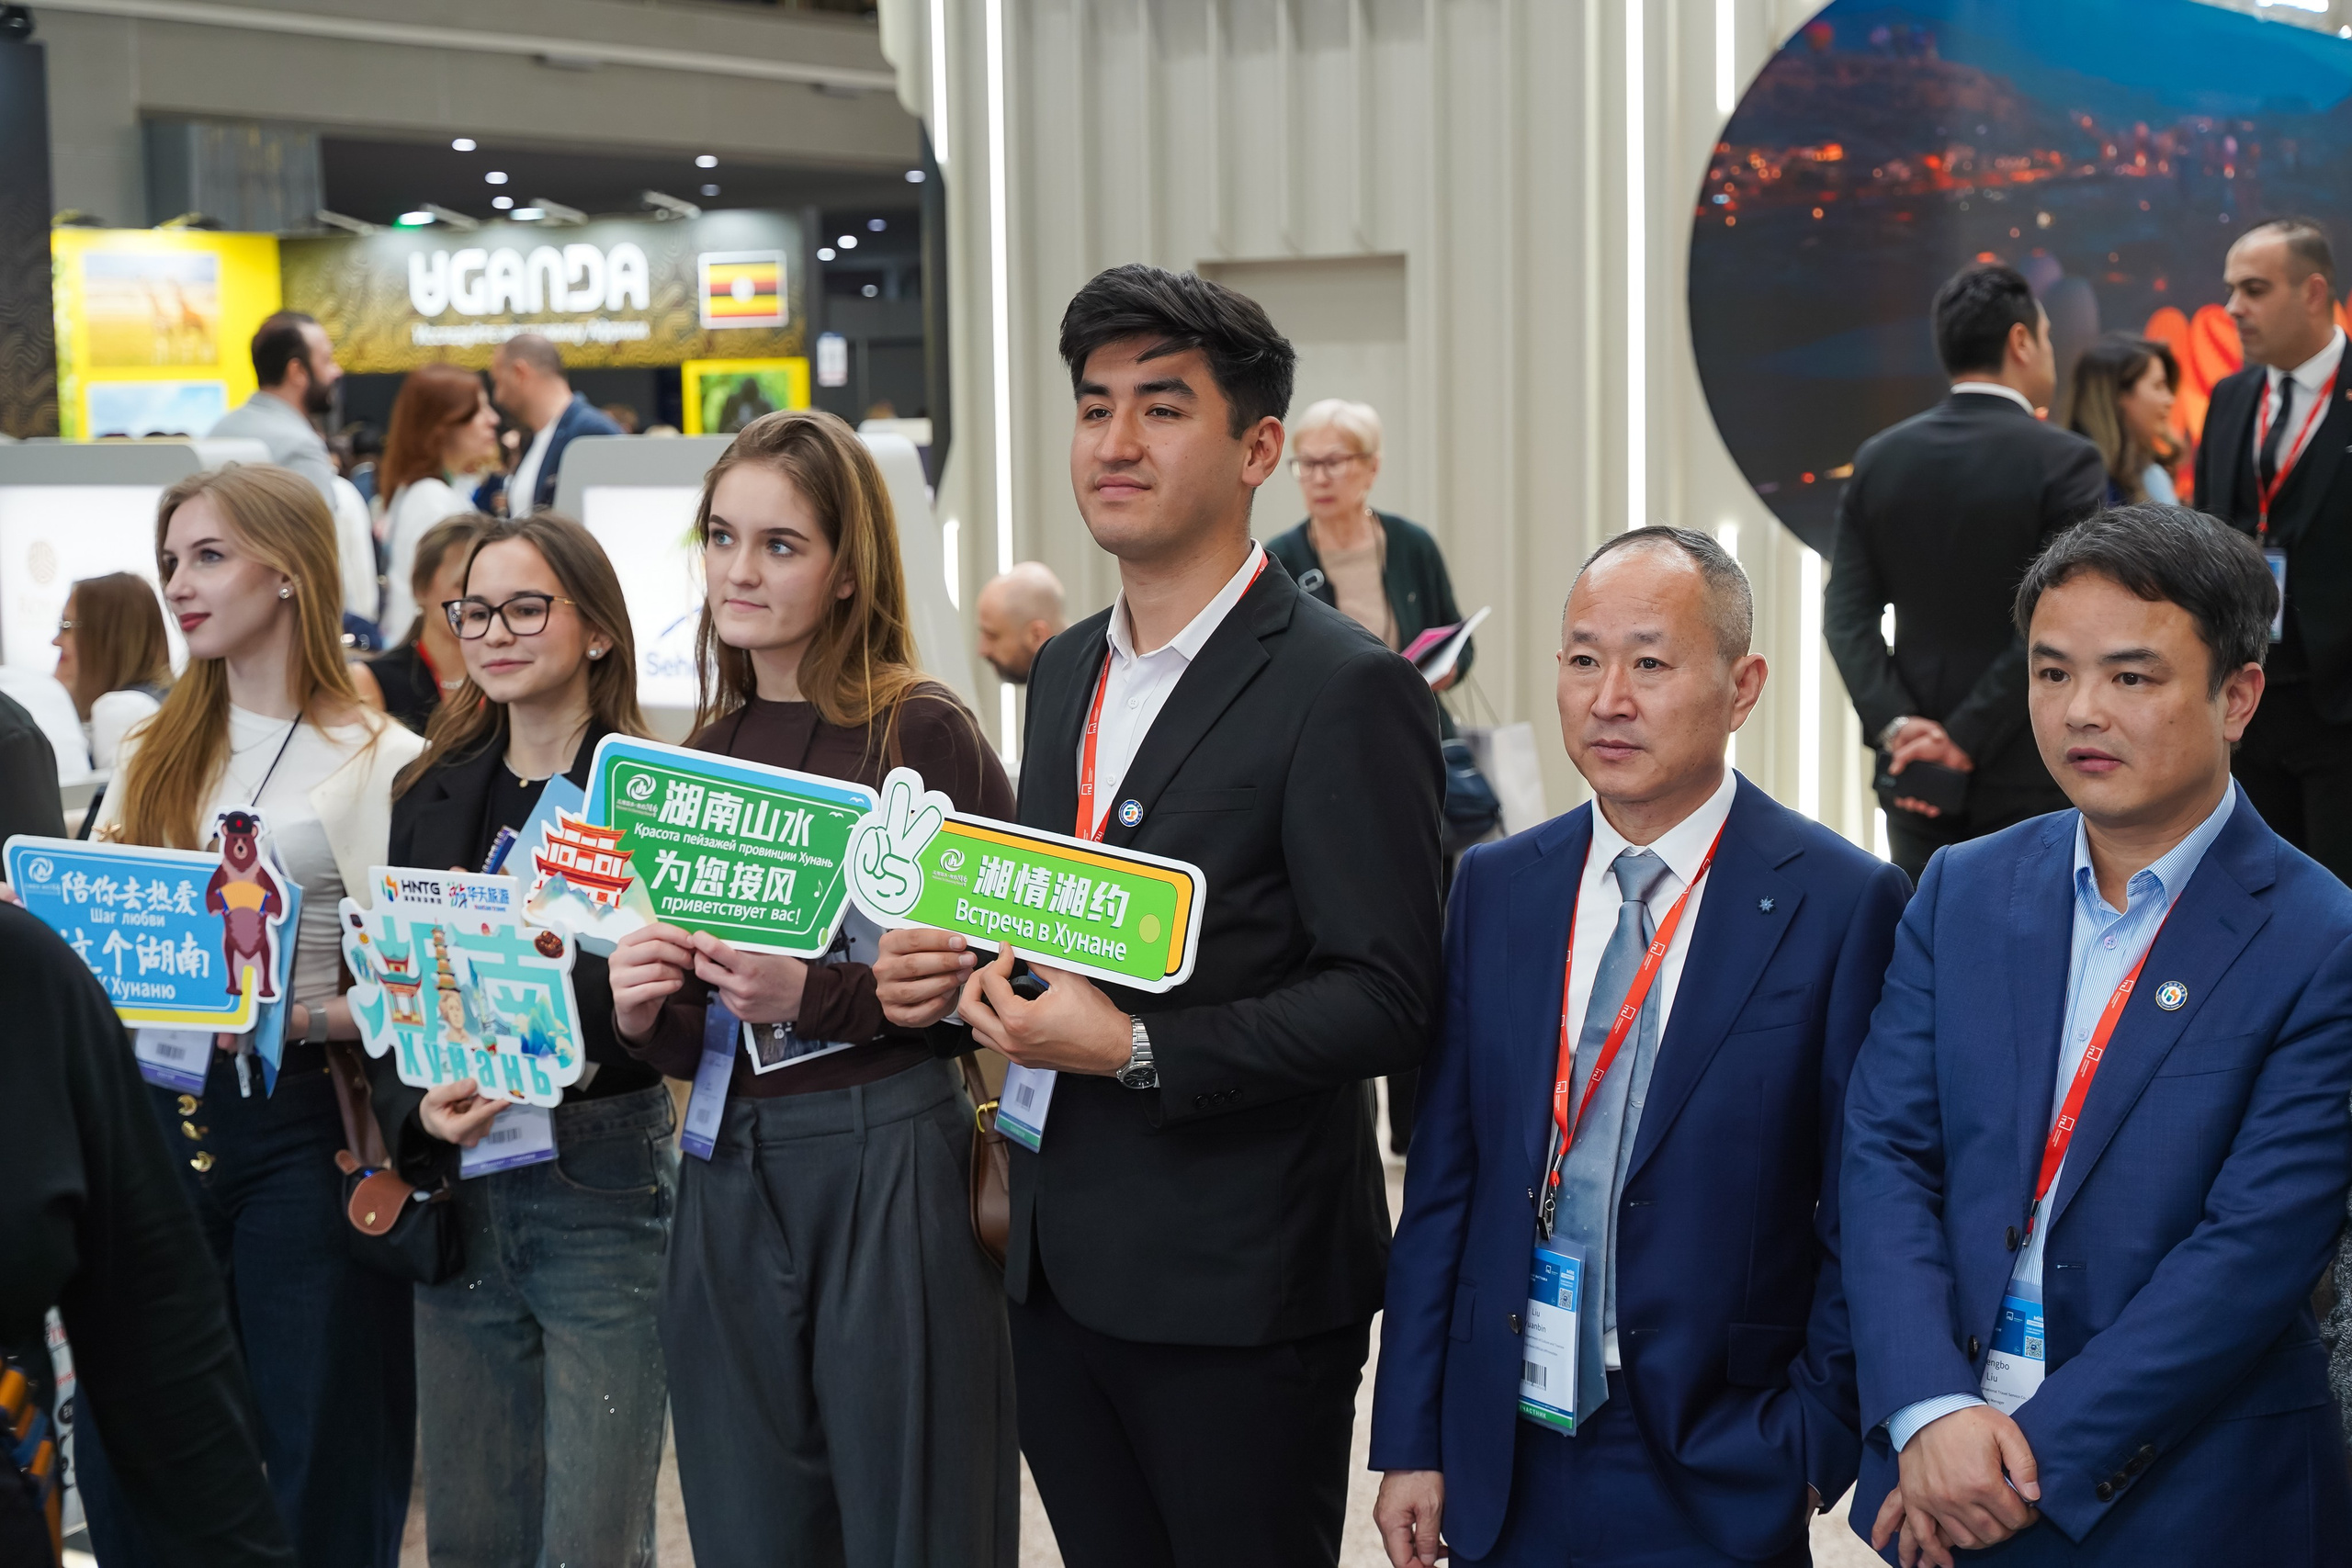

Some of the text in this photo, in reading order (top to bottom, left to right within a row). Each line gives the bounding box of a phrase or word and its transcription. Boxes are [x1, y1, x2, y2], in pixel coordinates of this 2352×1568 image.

[408, 242, 650, 317] UGANDA
[658, 779, 815, 847] 湖南山水
[634, 822, 833, 868] Красота пейзажей провинции Хунань
[61, 871, 198, 916] 陪你去热爱
[401, 880, 441, 896] HNTG
[650, 849, 797, 905] 为您接风
[972, 854, 1130, 928] 湘情湘约
[91, 908, 165, 928] Шаг любви
[661, 896, 801, 925] приветствует вас!
[955, 897, 1127, 962] Встреча в Хунане
[111, 976, 176, 1000] Хунаню
[1532, 1308, 1541, 1317] Liu
[1986, 1373, 1998, 1382] Liu
